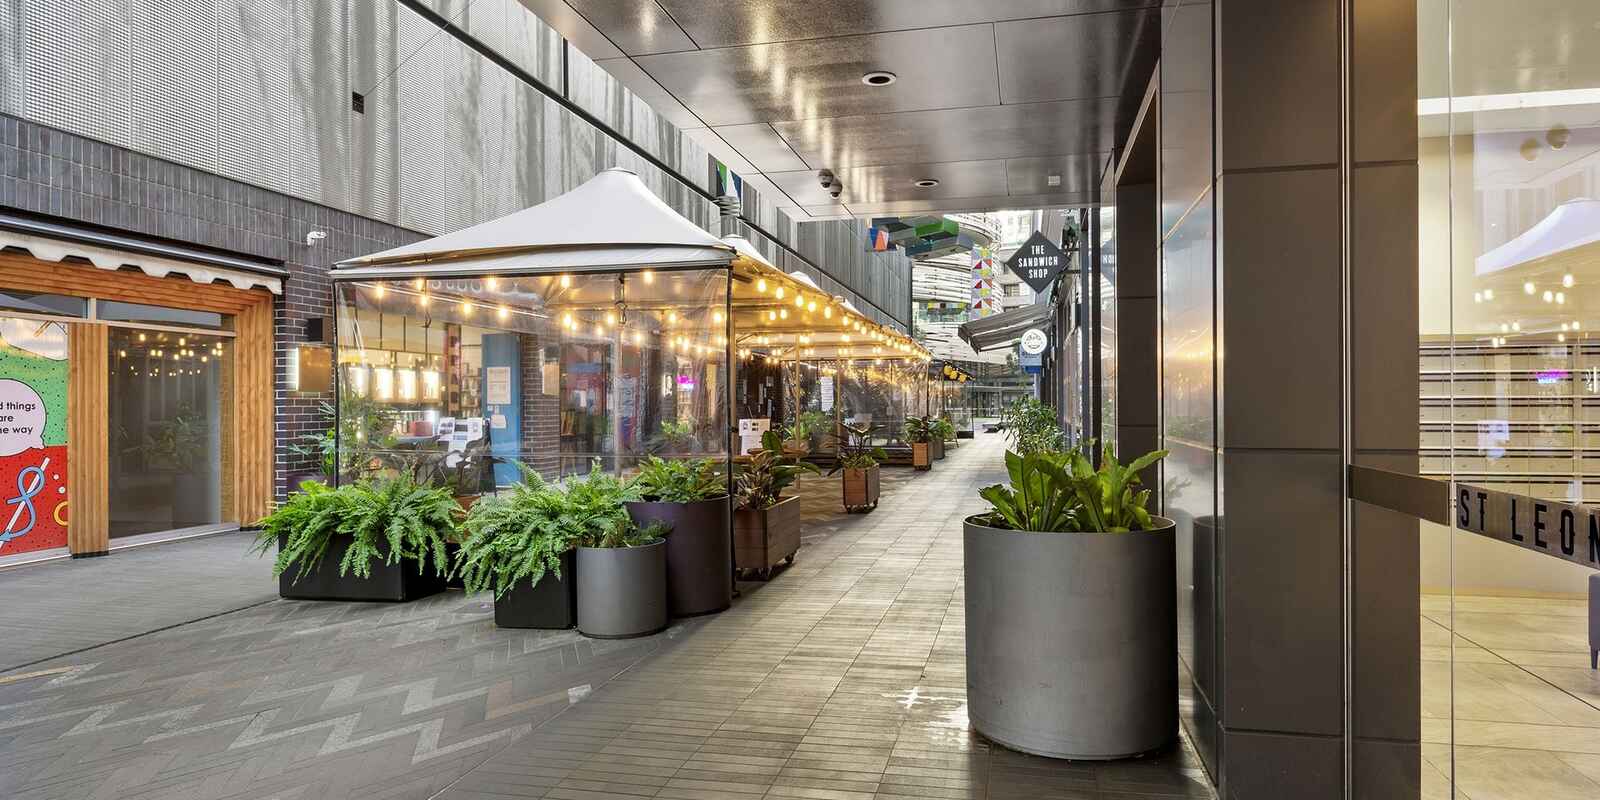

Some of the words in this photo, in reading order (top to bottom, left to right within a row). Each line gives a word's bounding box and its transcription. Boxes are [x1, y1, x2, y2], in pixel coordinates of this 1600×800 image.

[1031, 245, 1044, 255] THE
[1018, 256, 1058, 267] SANDWICH
[1029, 268, 1048, 278] SHOP
[6, 402, 36, 412] things
[12, 427, 33, 435] way
[1460, 489, 1487, 531] ST
